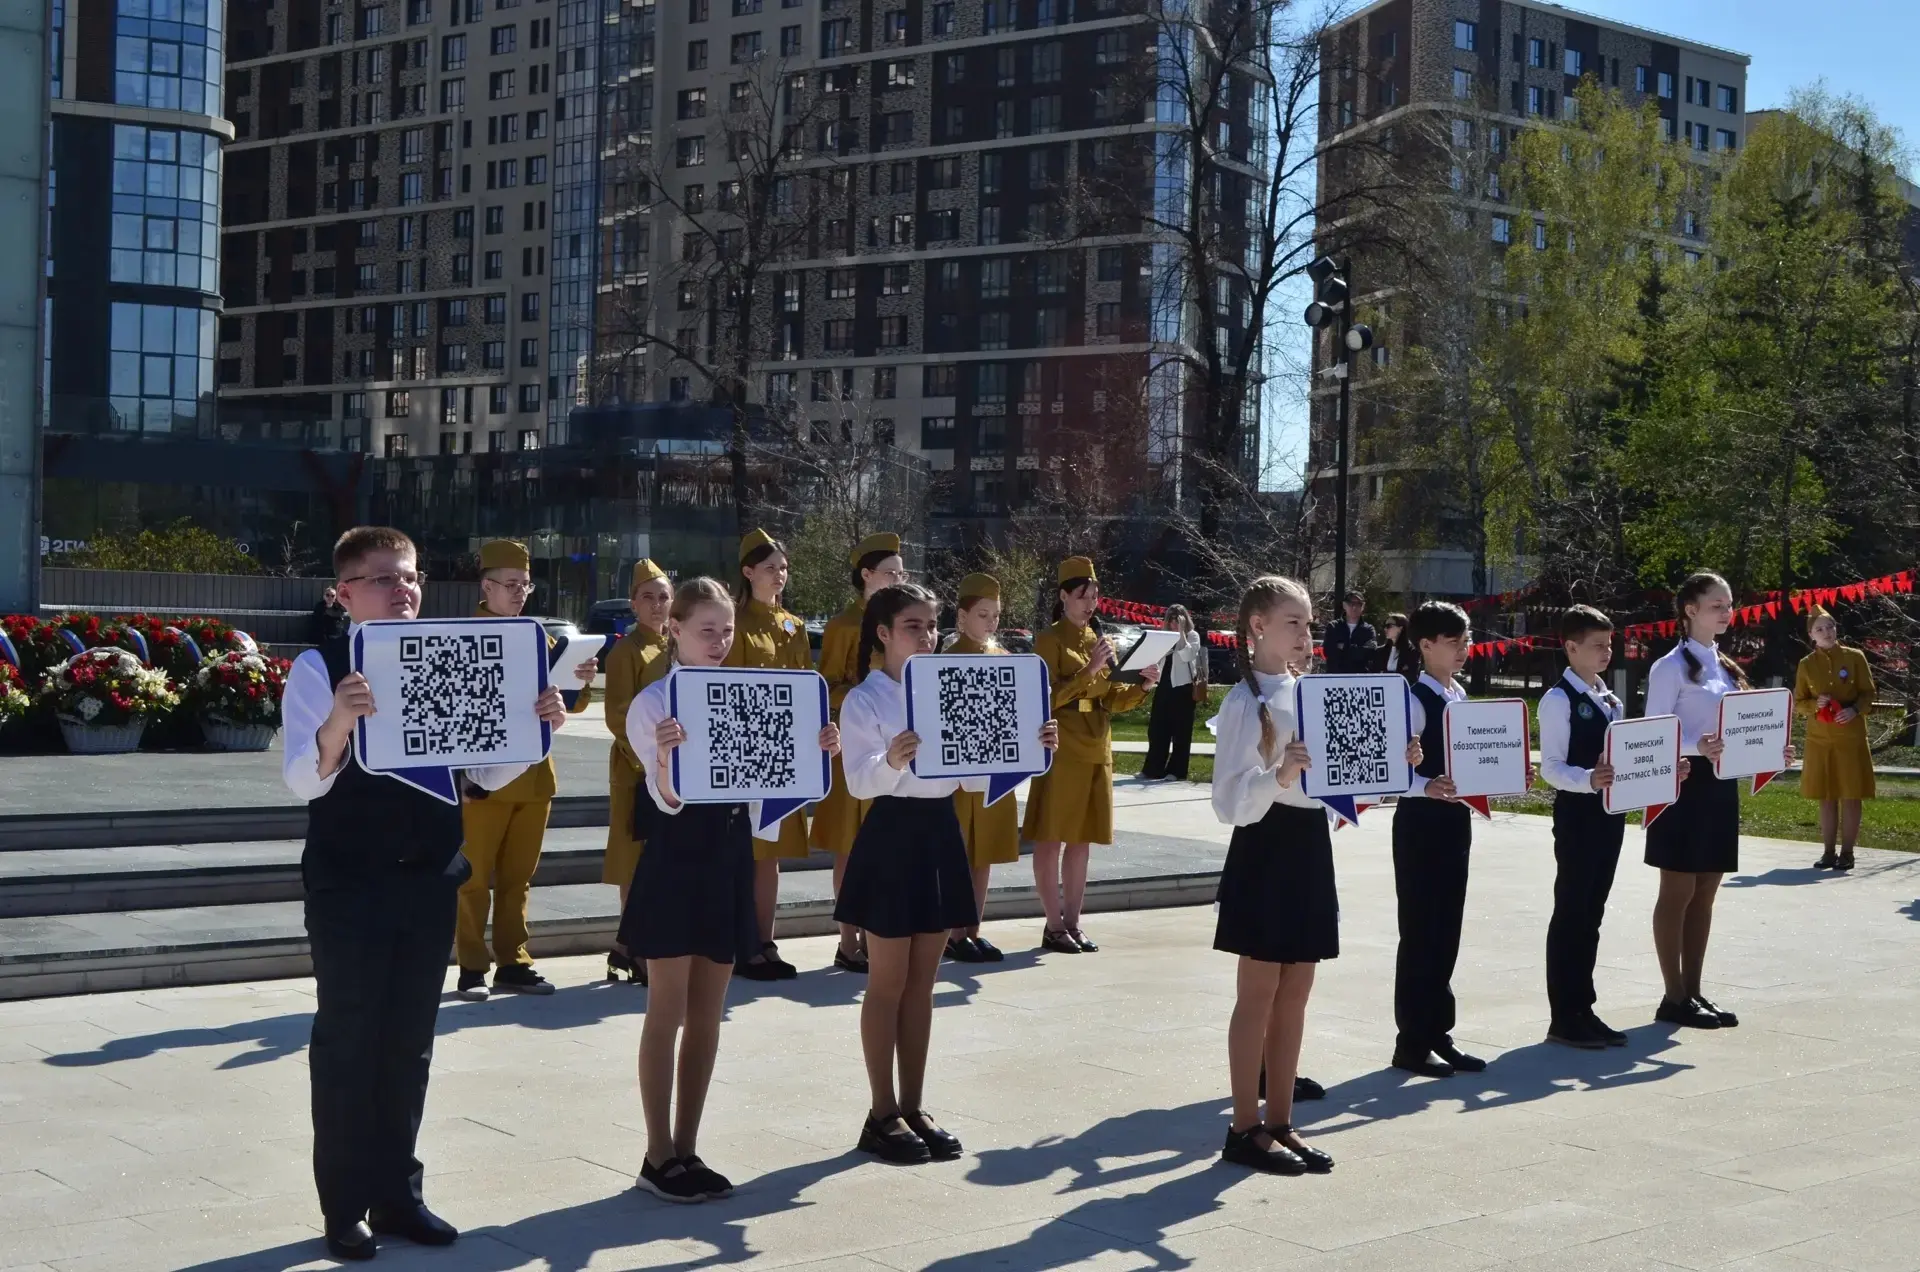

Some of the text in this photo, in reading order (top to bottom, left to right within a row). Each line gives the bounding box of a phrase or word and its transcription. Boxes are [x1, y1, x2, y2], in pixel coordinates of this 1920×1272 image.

[1737, 709, 1774, 720] Тюменский
[1467, 724, 1507, 735] Тюменский
[1725, 720, 1784, 737] судостроительный
[1453, 739, 1522, 752] обозостроительный
[1625, 736, 1664, 751] Тюменский
[1745, 737, 1764, 746] завод
[1478, 756, 1499, 765] завод
[1634, 755, 1654, 765] завод
[1615, 765, 1671, 782] пластмасс № 636
